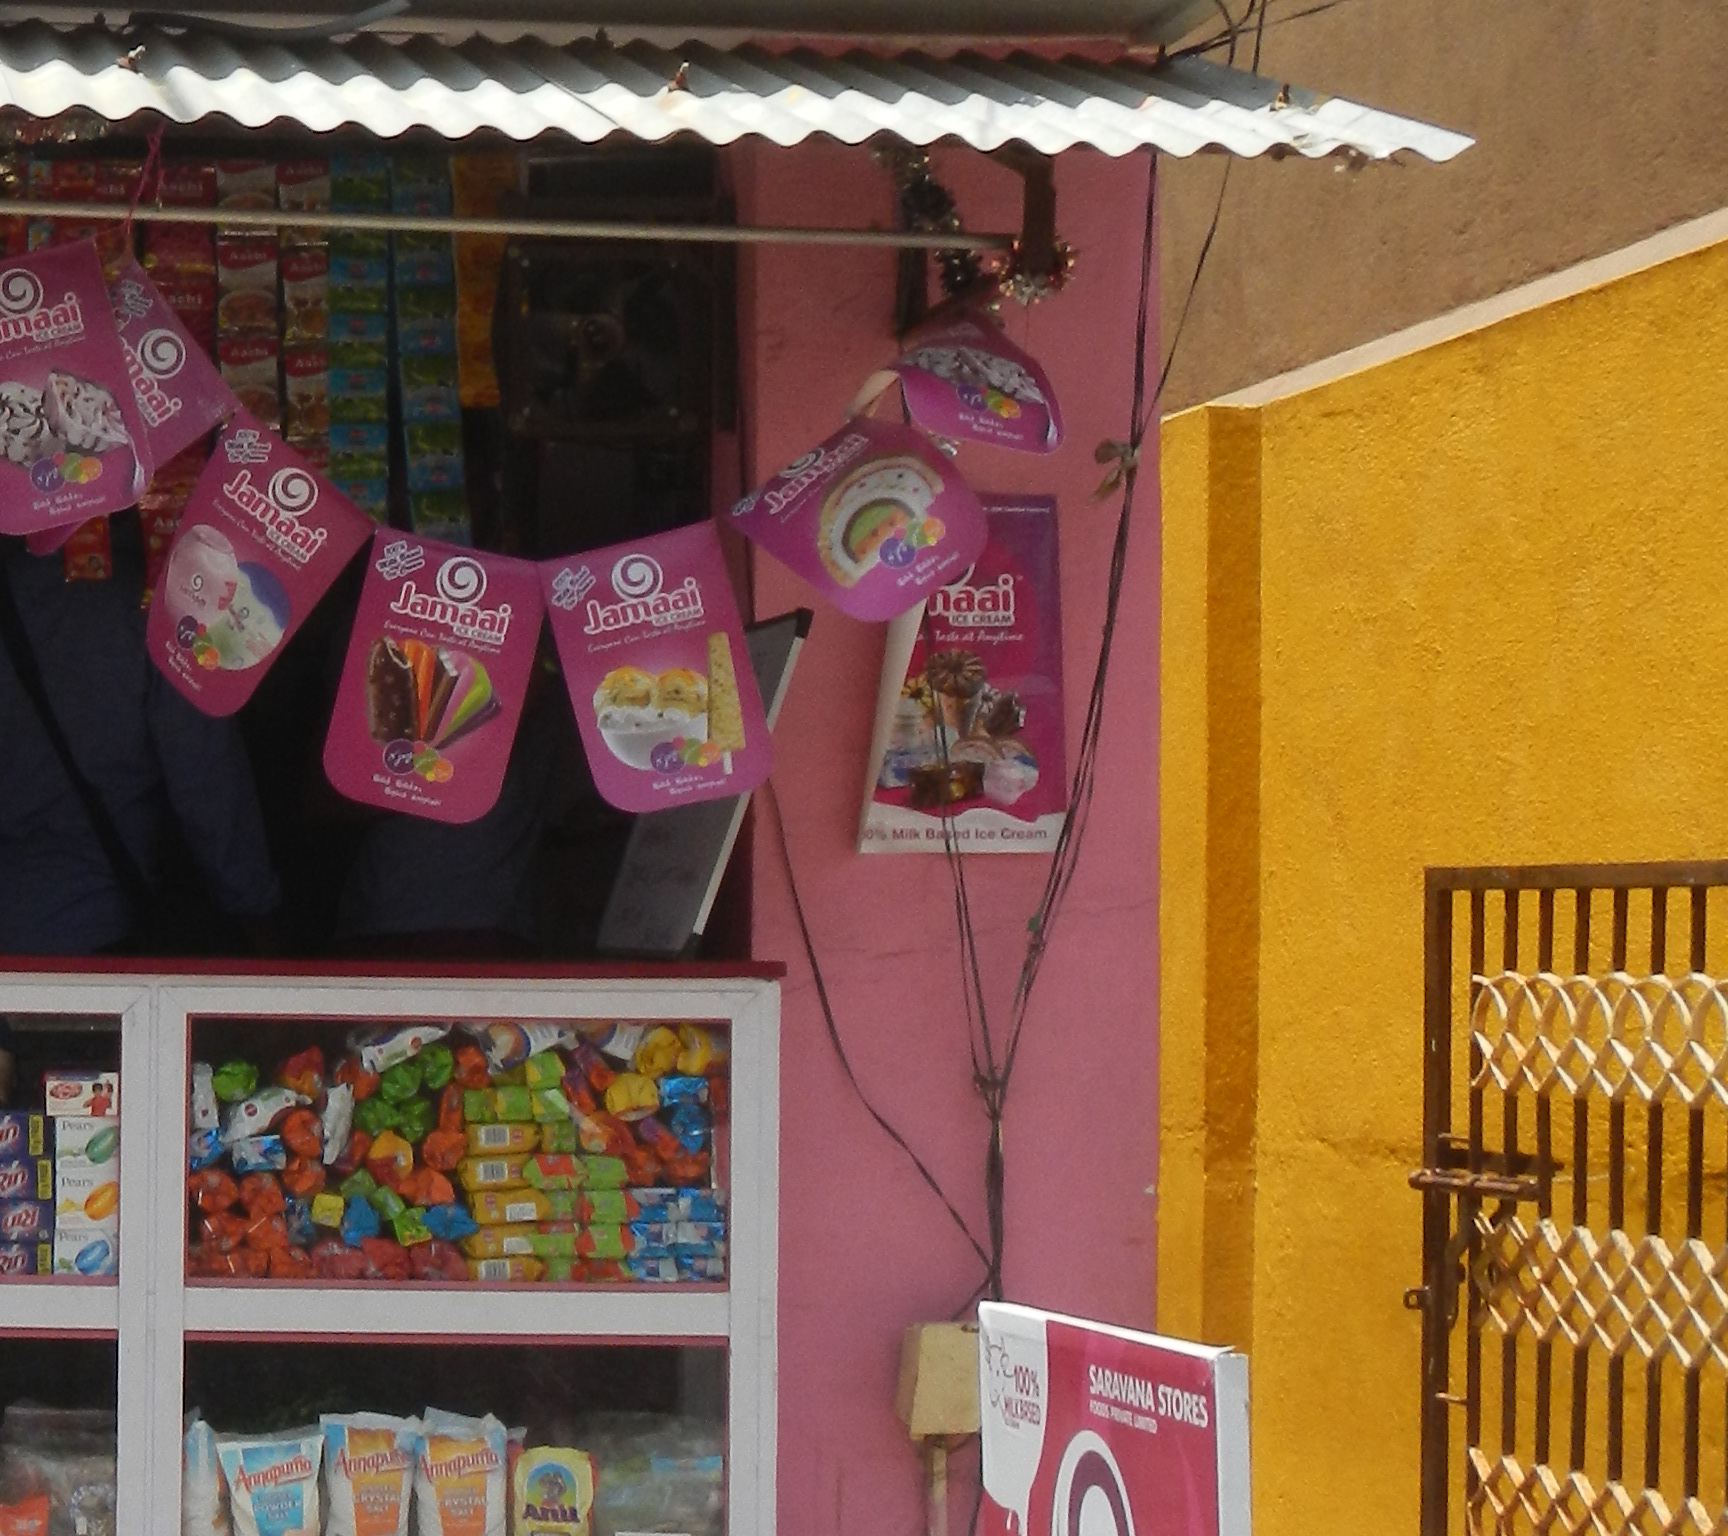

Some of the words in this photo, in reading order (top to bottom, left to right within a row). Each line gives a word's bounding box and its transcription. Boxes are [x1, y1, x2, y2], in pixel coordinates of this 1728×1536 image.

[224, 469, 328, 557] Jamaai
[390, 581, 511, 637] Jamaai
[584, 576, 702, 634] Jamaai
[975, 828, 995, 840] Ice
[1001, 827, 1047, 840] Cream
[1014, 1365, 1040, 1398] 100%
[1088, 1364, 1156, 1413] SARAVANA
[1158, 1383, 1208, 1429] STORES
